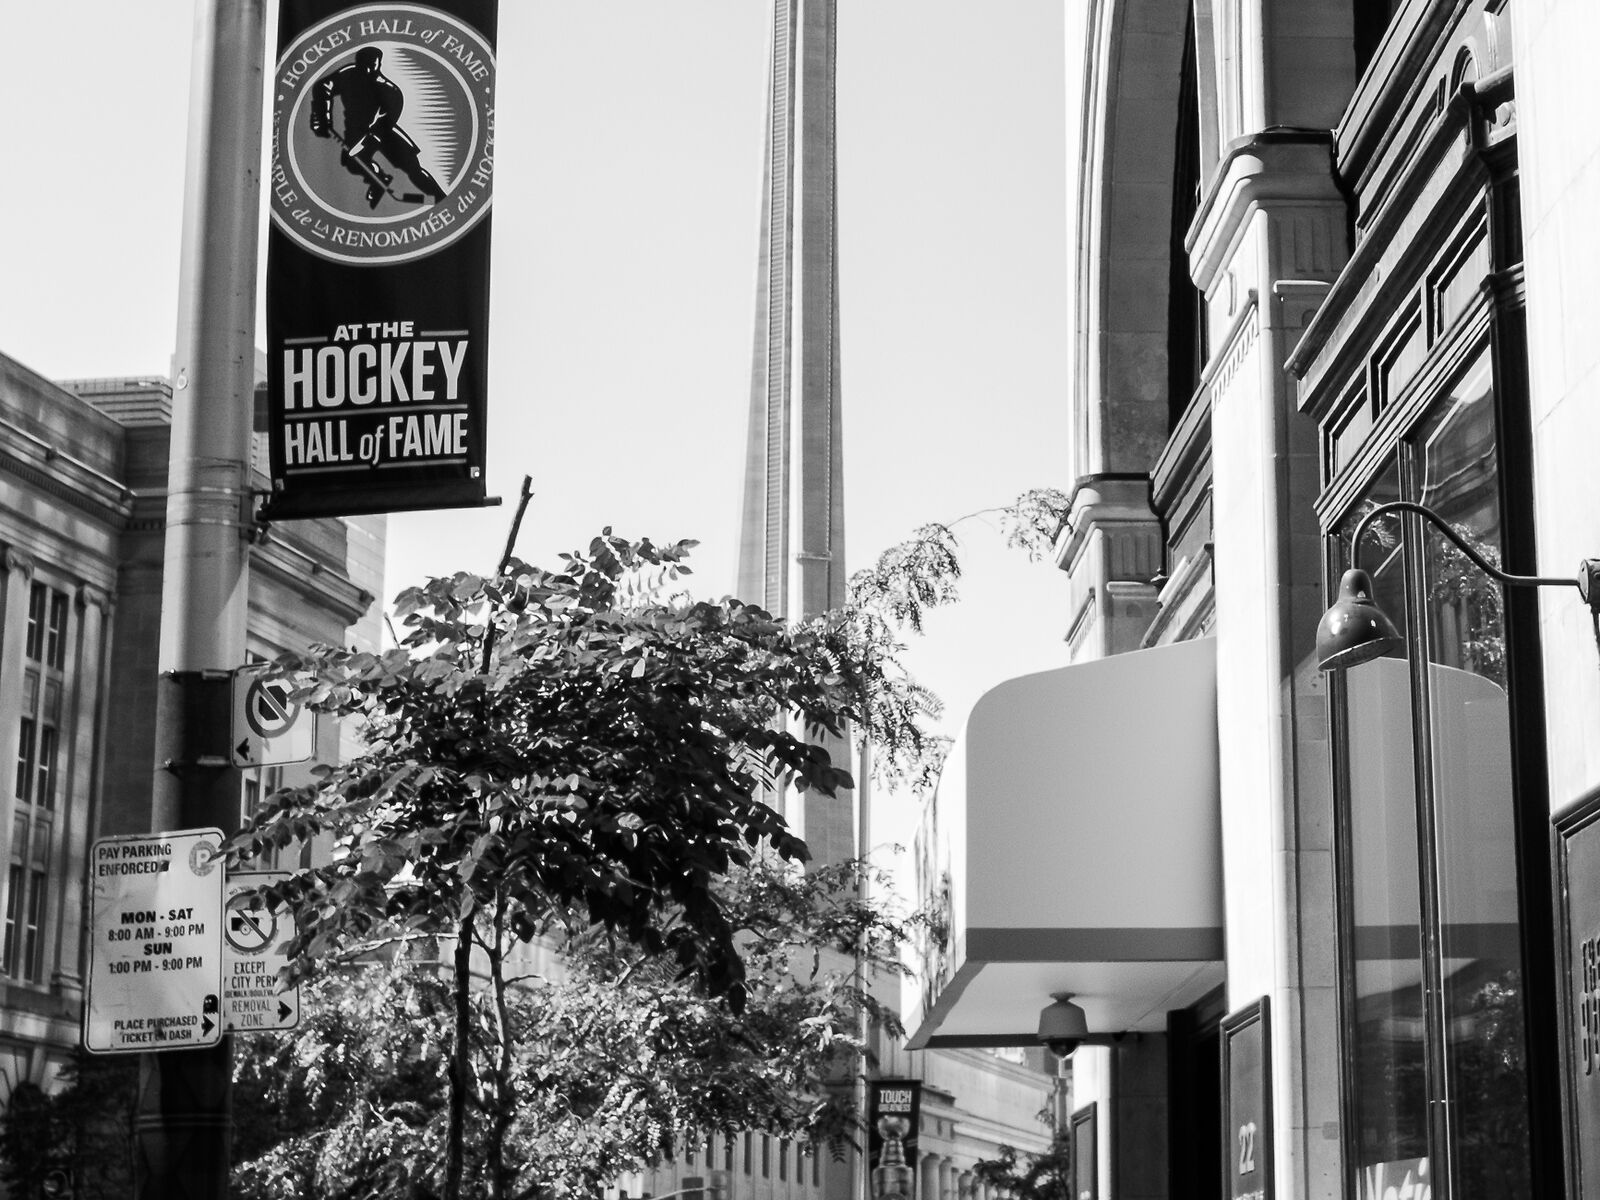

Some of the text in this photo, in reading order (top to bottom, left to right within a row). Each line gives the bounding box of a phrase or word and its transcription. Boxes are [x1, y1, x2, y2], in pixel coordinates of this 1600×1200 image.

[282, 19, 490, 89] HOCKEY HALL of FAME
[291, 208, 312, 226] de
[314, 219, 329, 235] LA
[331, 208, 456, 248] RENOMMÉE
[457, 190, 477, 214] du
[333, 320, 415, 342] AT THE
[284, 340, 469, 410] HOCKEY
[284, 413, 469, 466] HALL of FAME
[99, 843, 172, 860] PAY PARKING
[99, 860, 159, 877] ENFORCED
[121, 910, 156, 925] MON
[168, 907, 194, 921] SAT
[108, 929, 131, 942] 8:00
[135, 926, 155, 940] AM
[165, 925, 186, 938] 9:00
[188, 922, 205, 936] PM
[143, 942, 172, 956] SUN
[109, 961, 130, 974] 1:00
[133, 959, 152, 973] PM
[162, 958, 183, 971] 9:00
[186, 955, 203, 969] PM
[234, 961, 266, 975] EXCEPT
[231, 976, 251, 989] CITY
[232, 999, 272, 1013] REMOVAL
[114, 1015, 198, 1030] PLACE PURCHASED
[241, 1013, 264, 1027] ZONE
[121, 1031, 154, 1044] TICKET
[169, 1028, 192, 1041] DASH
[880, 1089, 912, 1104] TOUCH
[1239, 1122, 1256, 1175] 22
